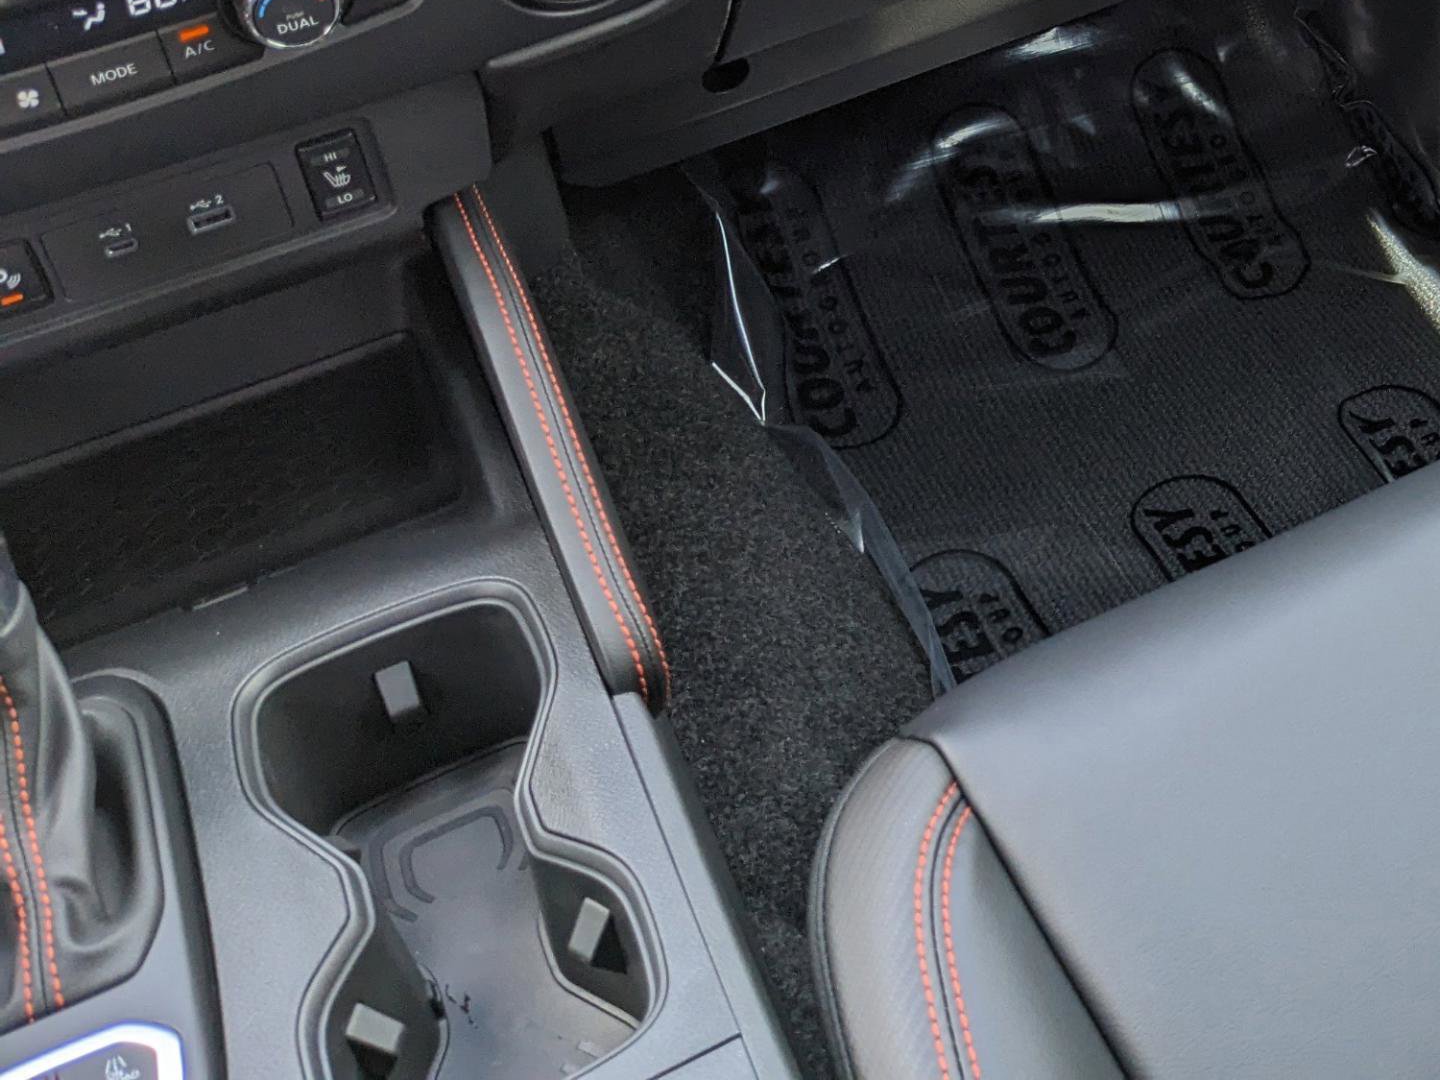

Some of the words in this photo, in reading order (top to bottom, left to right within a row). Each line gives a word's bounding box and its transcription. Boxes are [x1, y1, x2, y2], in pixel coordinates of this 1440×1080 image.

[276, 15, 319, 35] DUAL
[184, 39, 215, 59] A/C
[90, 63, 138, 86] MODE
[323, 151, 337, 162] HI
[337, 193, 353, 205] LO
